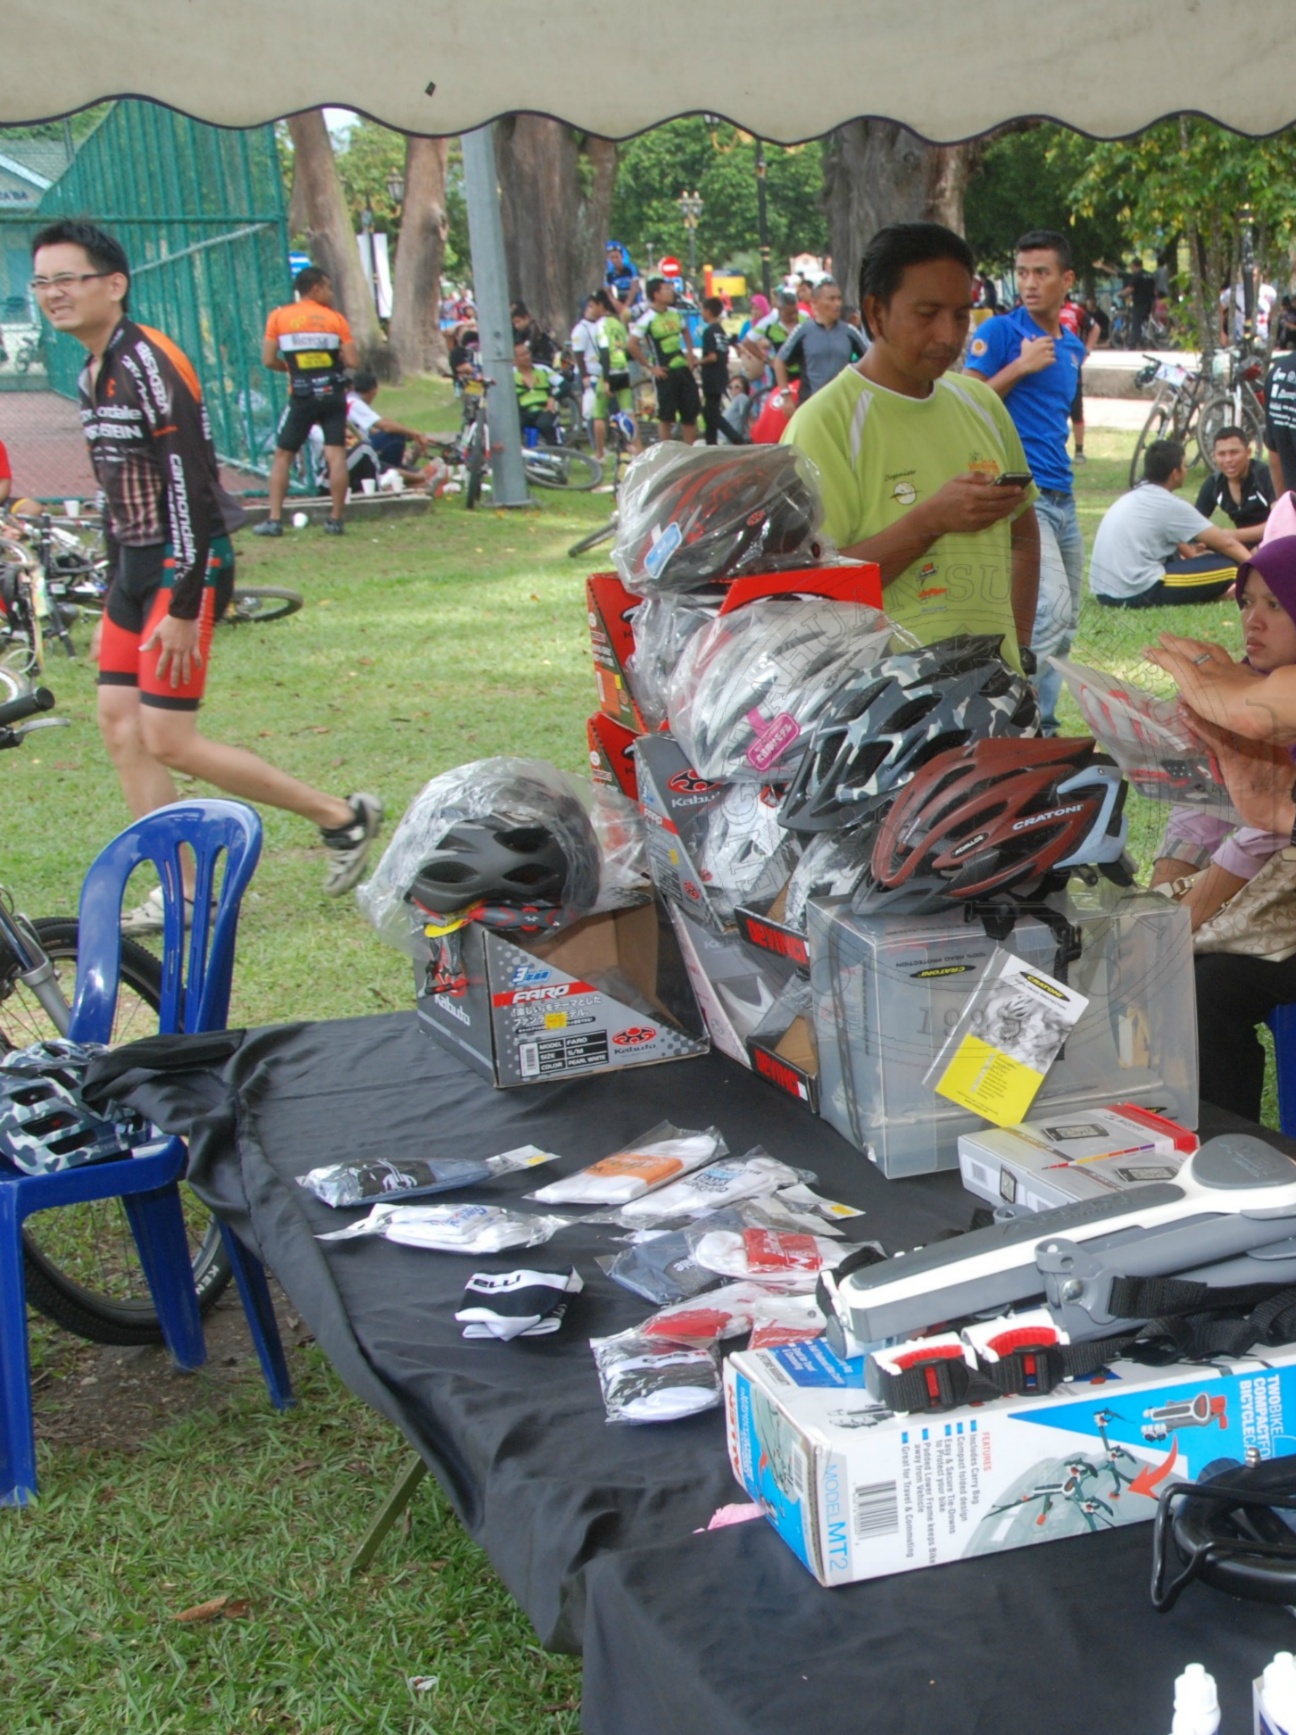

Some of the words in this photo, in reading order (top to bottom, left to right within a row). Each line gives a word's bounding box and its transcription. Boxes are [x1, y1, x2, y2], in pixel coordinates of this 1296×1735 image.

[1012, 803, 1084, 831] CRATONI
[512, 984, 570, 1005] FARO
[539, 1042, 562, 1051] MODEL
[540, 1052, 556, 1060] SIZE
[541, 1061, 563, 1071] COLOR
[901, 1446, 911, 1467] Great
[913, 1444, 922, 1464] away
[923, 1442, 932, 1471] Padded
[944, 1438, 953, 1456] Easy
[956, 1436, 966, 1469] Compact
[970, 1433, 979, 1466] Includes
[982, 1431, 992, 1472] FEATURES
[902, 1468, 911, 1479] for
[915, 1465, 923, 1484] from
[936, 1449, 945, 1478] Protect
[924, 1472, 933, 1496] Lower
[936, 1479, 945, 1495] your
[945, 1465, 954, 1493] Secure
[958, 1470, 968, 1495] folded
[970, 1467, 980, 1488] Carry
[823, 1463, 840, 1522] MODEL
[903, 1480, 913, 1505] Travel
[916, 1484, 925, 1513] Vehicle
[971, 1489, 981, 1505] Bag
[926, 1497, 935, 1522] Frame
[938, 1497, 946, 1513] bike
[959, 1496, 968, 1522] design
[905, 1514, 915, 1559] Commuting
[927, 1523, 936, 1546] keeps
[827, 1521, 849, 1573] MT2
[928, 1547, 938, 1565] Bike
